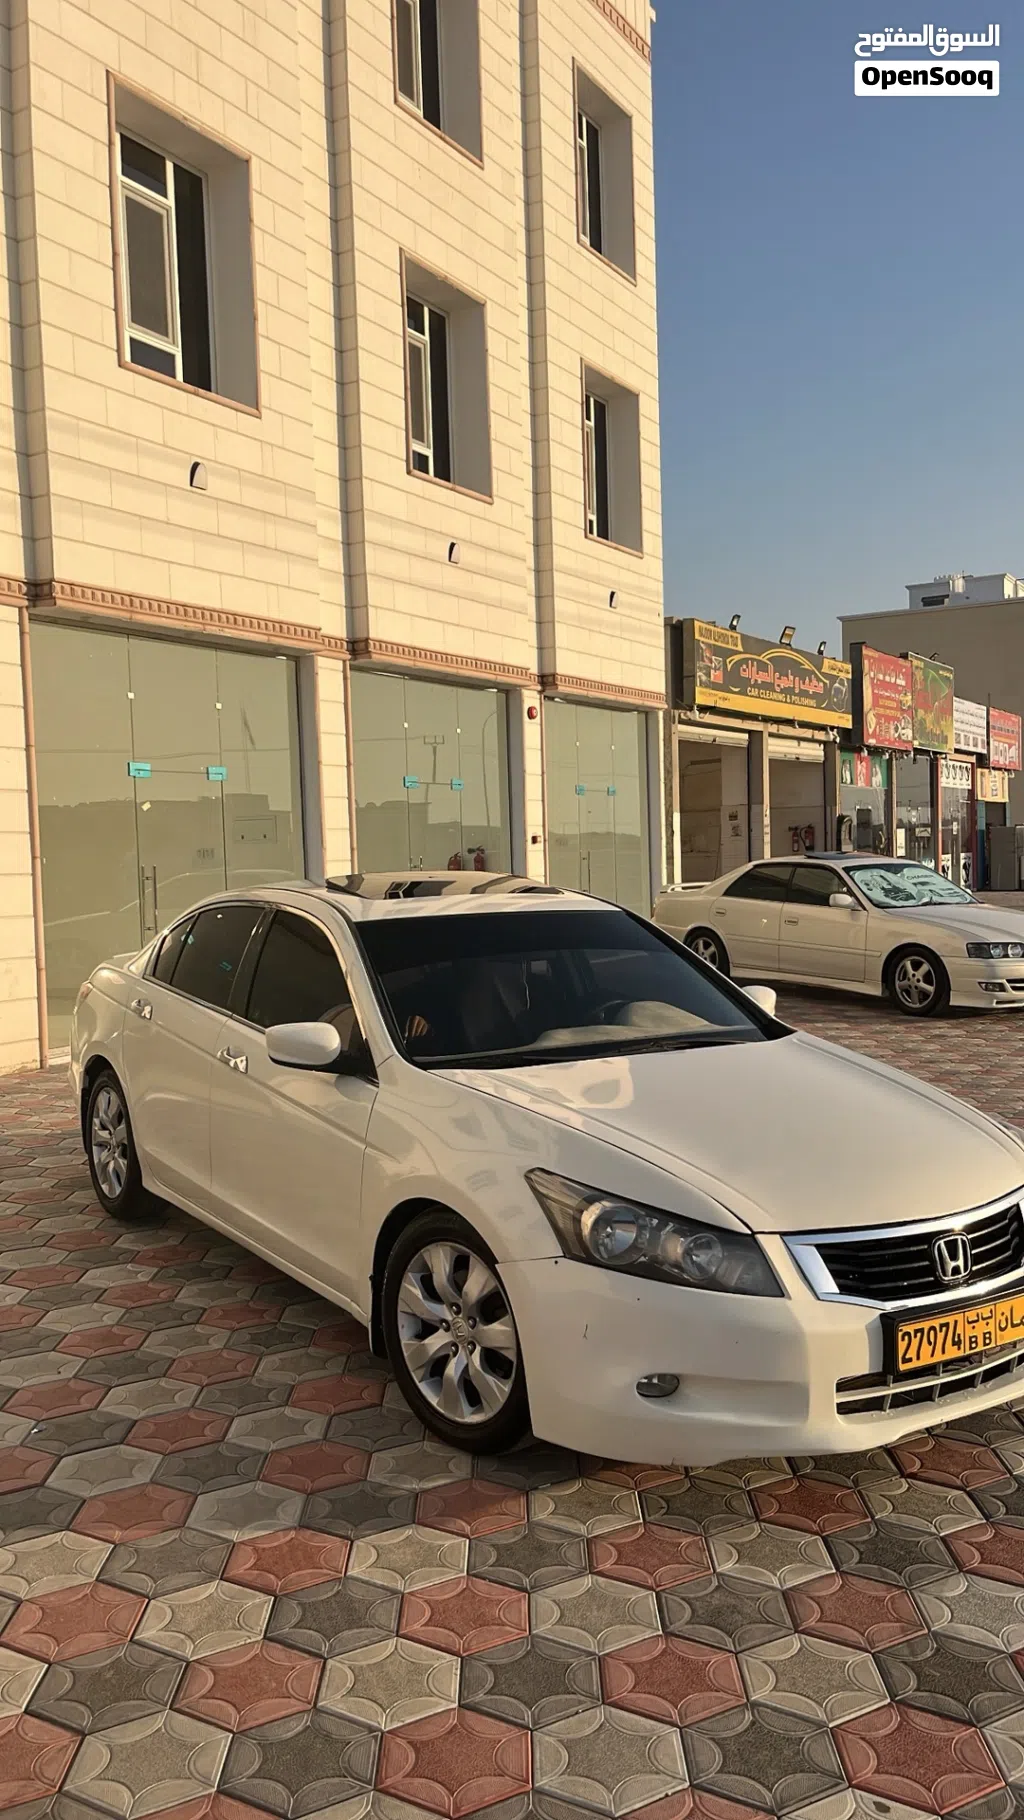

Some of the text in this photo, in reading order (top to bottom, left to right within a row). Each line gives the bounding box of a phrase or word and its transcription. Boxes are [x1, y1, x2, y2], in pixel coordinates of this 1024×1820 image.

[740, 660, 774, 684] السيارات
[747, 687, 759, 696] CAR
[760, 689, 786, 702] CLEANING
[791, 695, 817, 707] POLISHING
[900, 1319, 963, 1365] 27974
